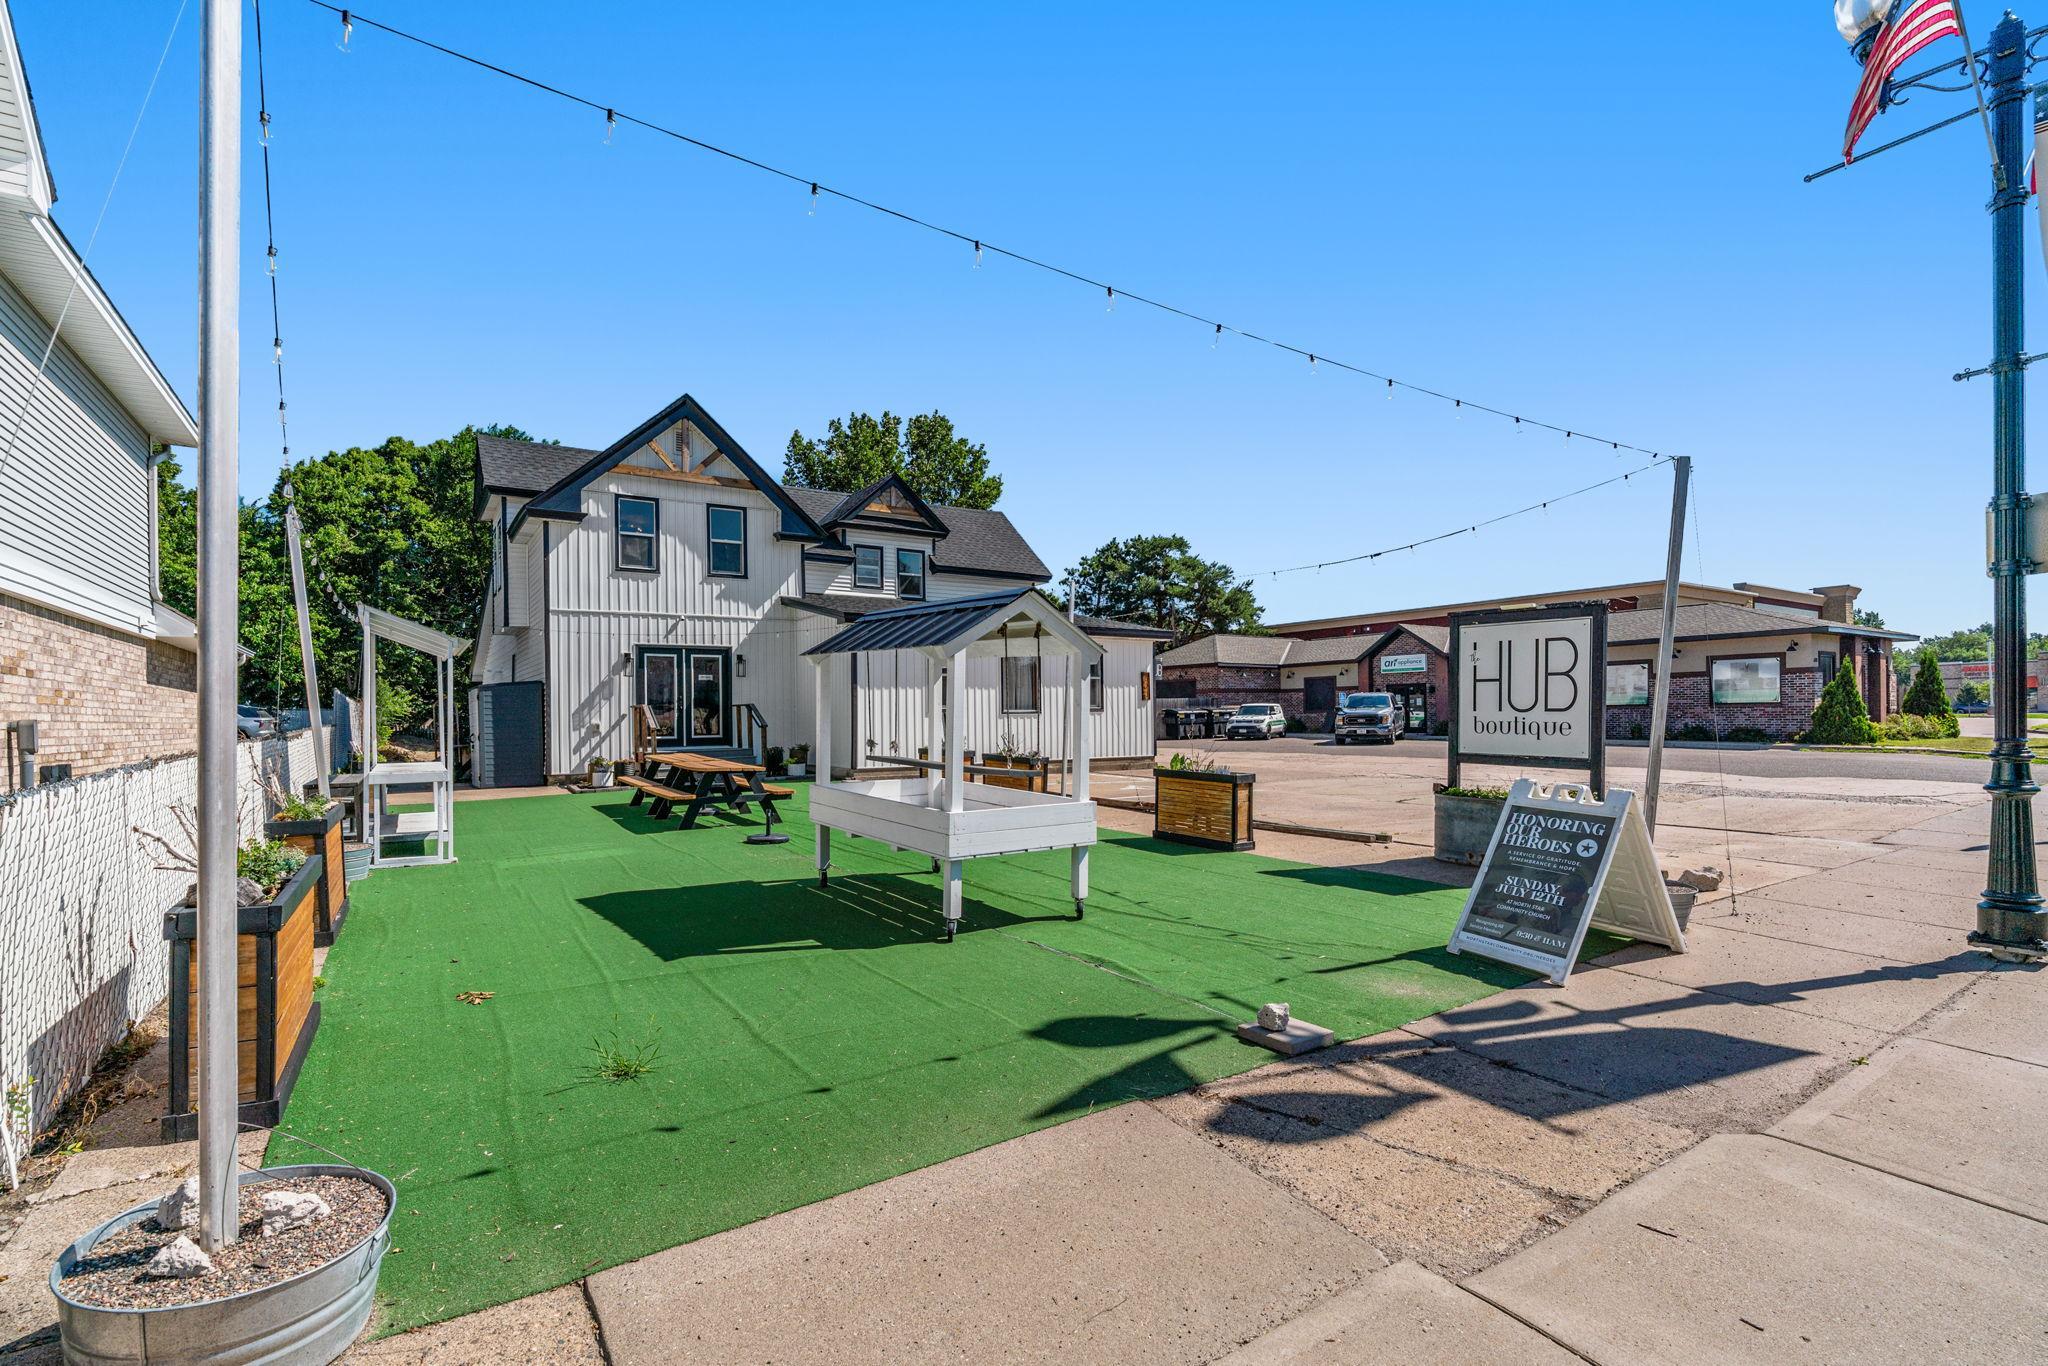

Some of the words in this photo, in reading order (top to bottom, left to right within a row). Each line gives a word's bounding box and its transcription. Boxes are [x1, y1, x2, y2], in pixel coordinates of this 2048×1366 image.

[1398, 658, 1422, 666] appliance
[1473, 637, 1579, 713] HUB
[1473, 716, 1572, 740] boutique
[1506, 823, 1542, 838] OUR
[1510, 812, 1606, 836] HONORING
[1503, 833, 1573, 855] HEROES
[1509, 856, 1551, 867] REMEMBRANCE
[1495, 883, 1530, 898] JULY
[1530, 889, 1566, 907] 12TH
[1505, 875, 1561, 895] SUNDAY,
[1496, 903, 1528, 915] COMMUNITY
[1528, 911, 1551, 920] CHURCH
[1516, 930, 1533, 940] 9:30
[1542, 937, 1566, 949] 11AM
